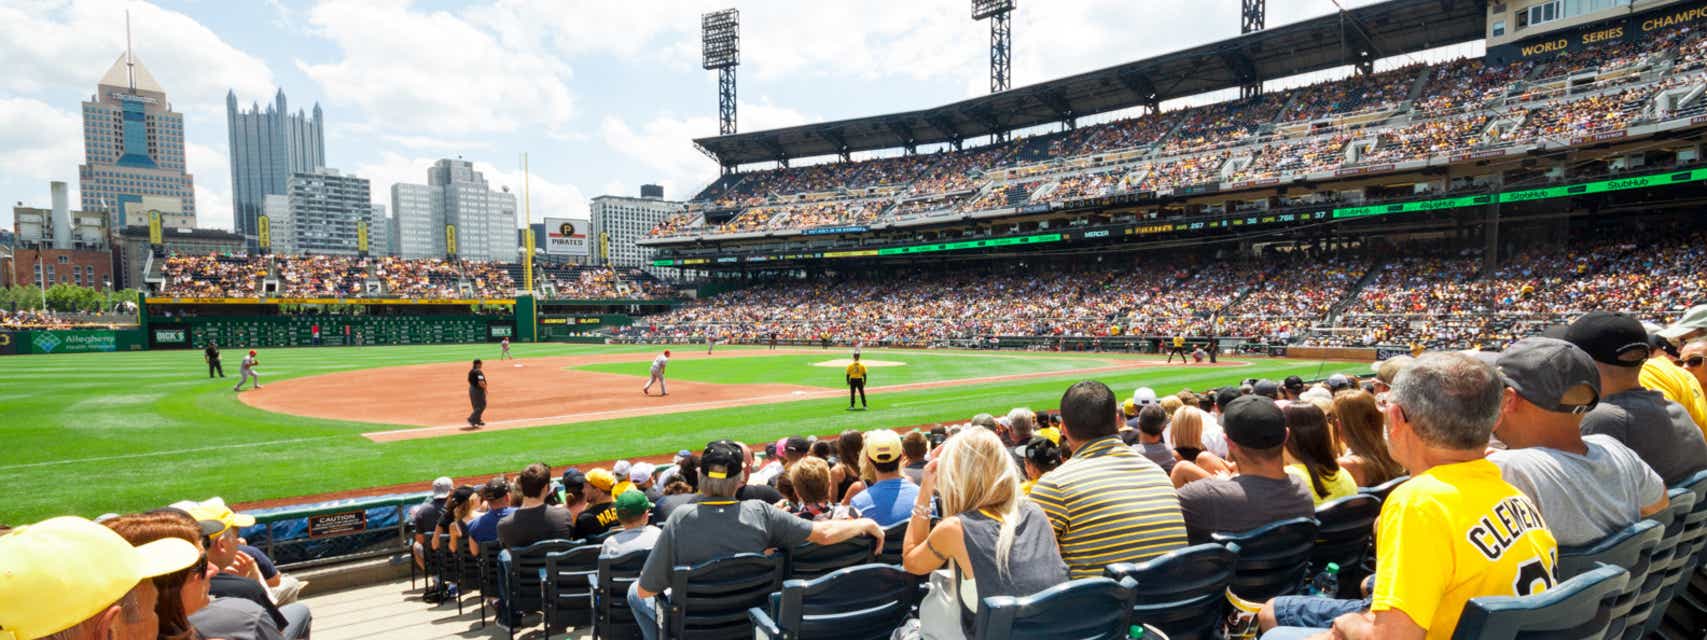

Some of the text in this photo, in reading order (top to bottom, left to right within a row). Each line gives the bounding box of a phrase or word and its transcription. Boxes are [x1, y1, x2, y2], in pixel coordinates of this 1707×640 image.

[1521, 39, 1568, 57] WORLD
[1582, 27, 1624, 45] SERIES
[1607, 176, 1649, 190] StubHub
[1084, 229, 1110, 238] MERCER
[551, 238, 583, 246] PIRATES
[65, 335, 116, 344] Allegheny
[155, 331, 185, 342] DICK'S
[319, 513, 356, 523] CAUTION
